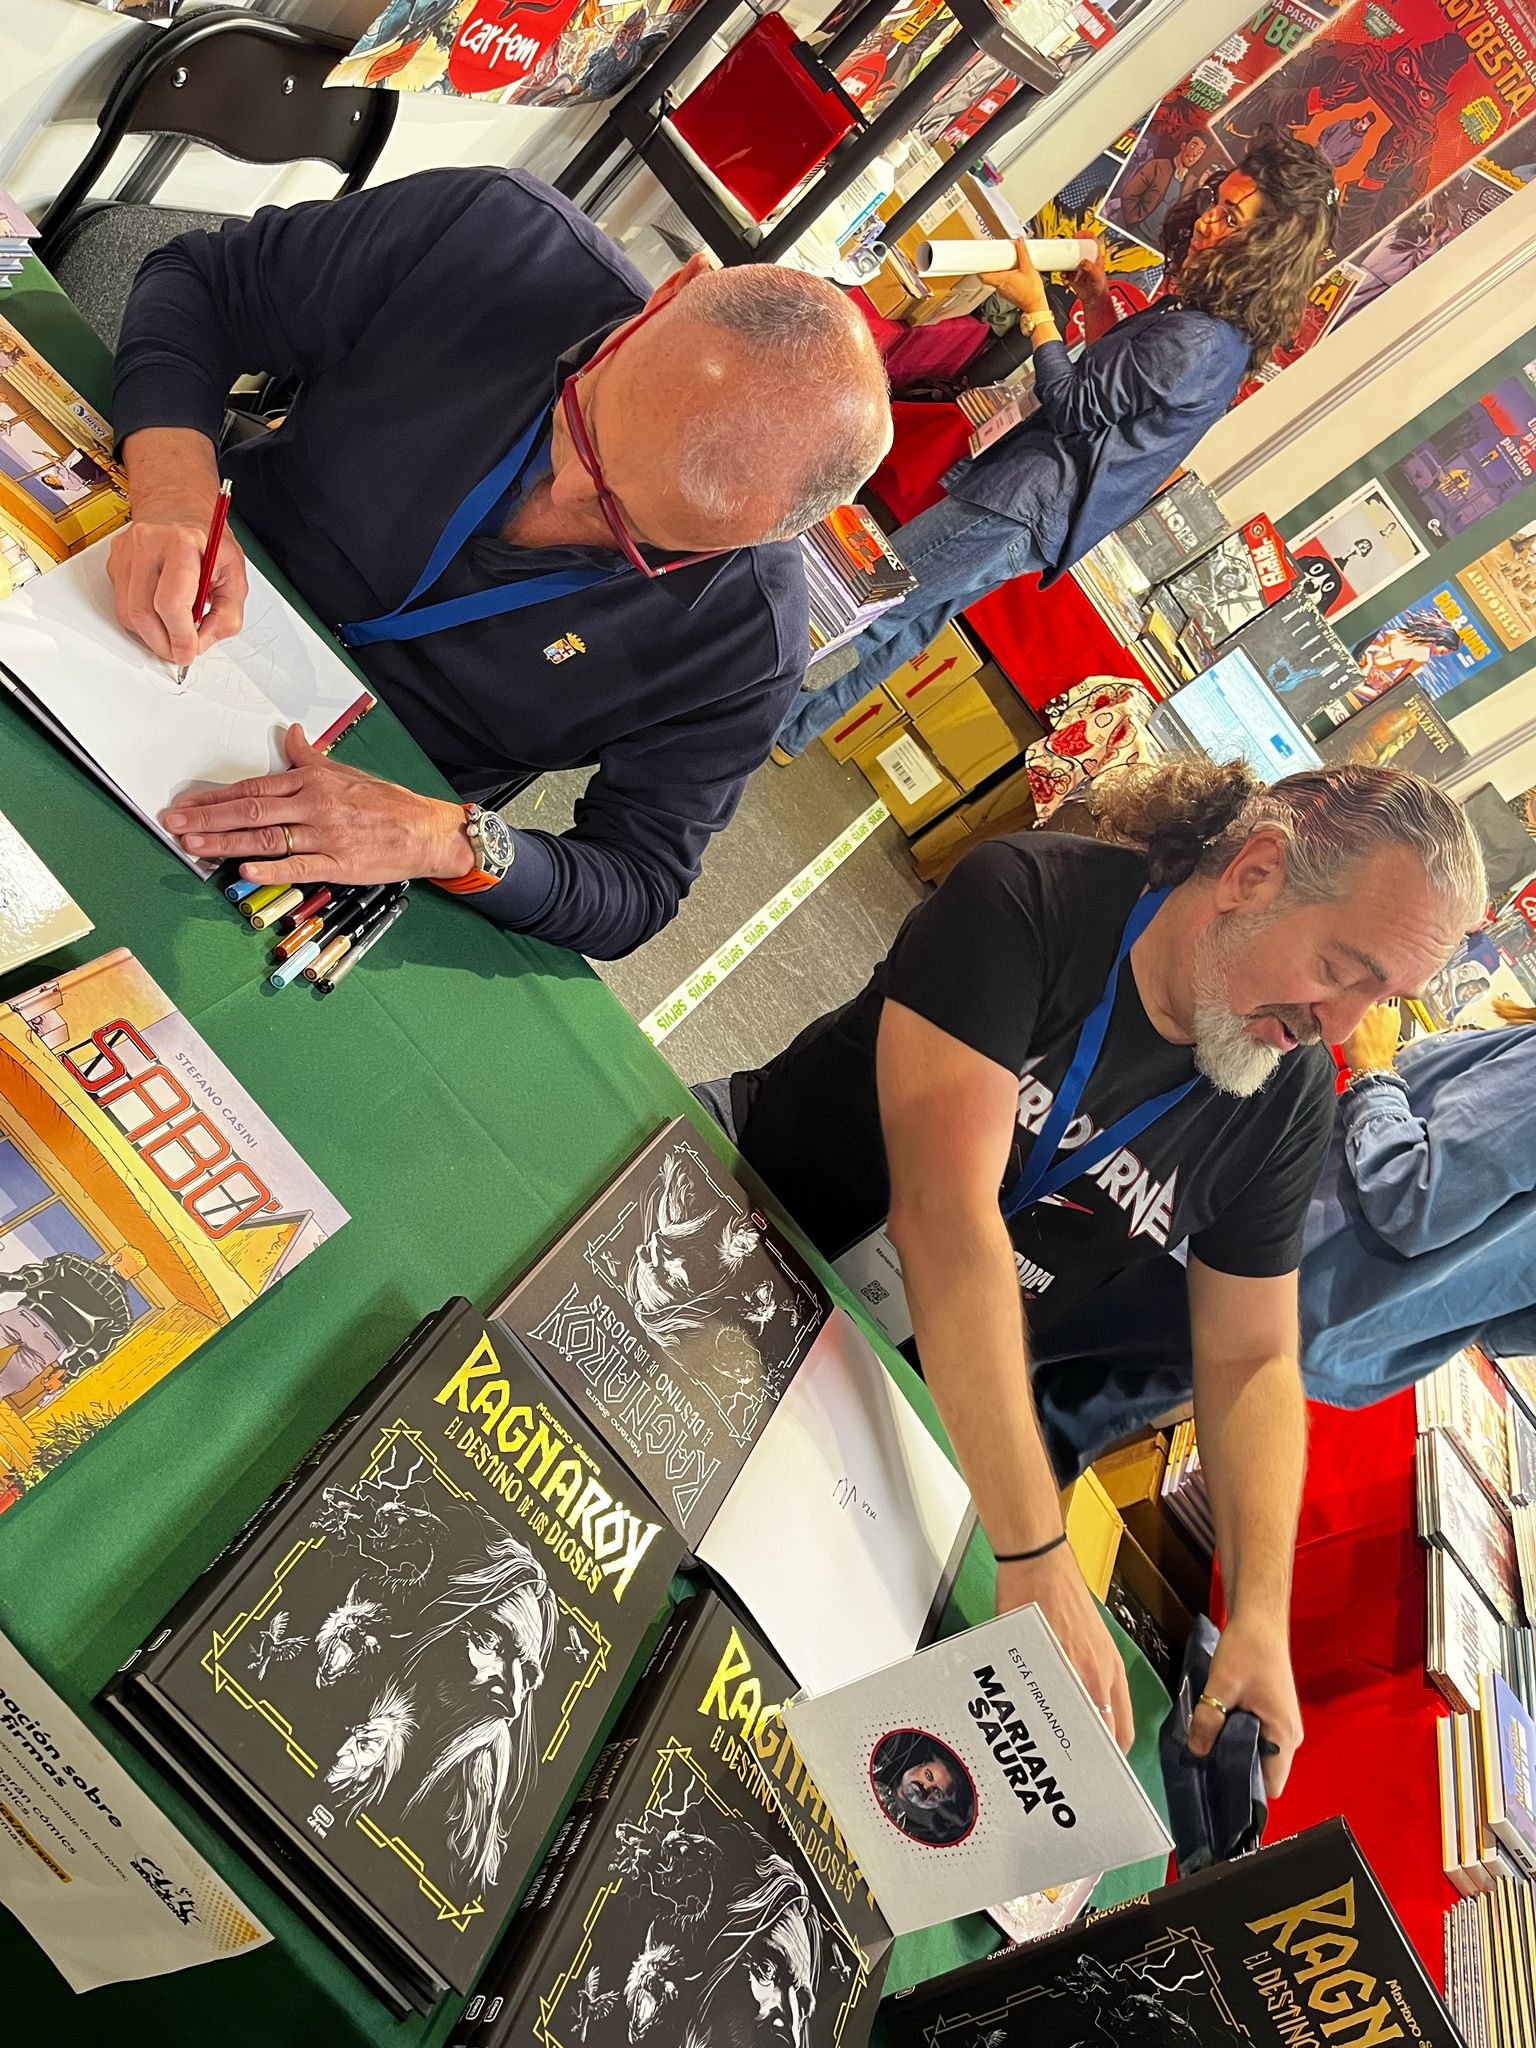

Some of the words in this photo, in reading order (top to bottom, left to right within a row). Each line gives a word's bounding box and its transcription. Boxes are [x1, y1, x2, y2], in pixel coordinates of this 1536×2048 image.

[1264, 14, 1312, 53] BE
[1440, 0, 1486, 30] UY
[1495, 15, 1528, 60] PASADO
[1433, 590, 1462, 623] BOB
[1452, 614, 1469, 633] &
[1459, 622, 1491, 662] JANIS
[1404, 697, 1450, 754] FRAZETTA
[768, 897, 793, 922] servis
[791, 877, 814, 899] servis
[743, 920, 768, 945] servis
[718, 944, 744, 971] servis
[688, 971, 717, 1000] servis
[656, 999, 688, 1030] servis
[175, 1052, 224, 1107] STEFANO
[221, 1107, 259, 1149] CASINI
[588, 1293, 638, 1355] DIOSES
[655, 1373, 706, 1438] DESTINO
[536, 1401, 573, 1448] Mariano
[572, 1443, 601, 1477] Saura
[610, 1418, 643, 1458] Mariano
[444, 1415, 461, 1441] EL
[456, 1426, 523, 1503] DESTINO
[516, 1493, 535, 1519] DE
[528, 1505, 550, 1536] LOS
[544, 1519, 604, 1595] DIOSES
[1008, 1647, 1034, 1680] ESTÁ
[0, 1714, 67, 1788] firmas
[967, 1696, 1042, 1816] SAURA
[972, 1664, 1077, 1829] MARIANO
[13, 1755, 47, 1793] número
[47, 1793, 79, 1828] posible
[79, 1827, 92, 1842] de
[61, 1764, 122, 1829] sobre
[709, 1724, 723, 1749] EL
[721, 1738, 781, 1814] DESTINO
[803, 1831, 857, 1904] DIOSES
[0, 1803, 67, 1881] cs/persona
[33, 1805, 77, 1856] cómics
[1242, 1950, 1272, 1971] EL
[1384, 1978, 1423, 2039] Mariano
